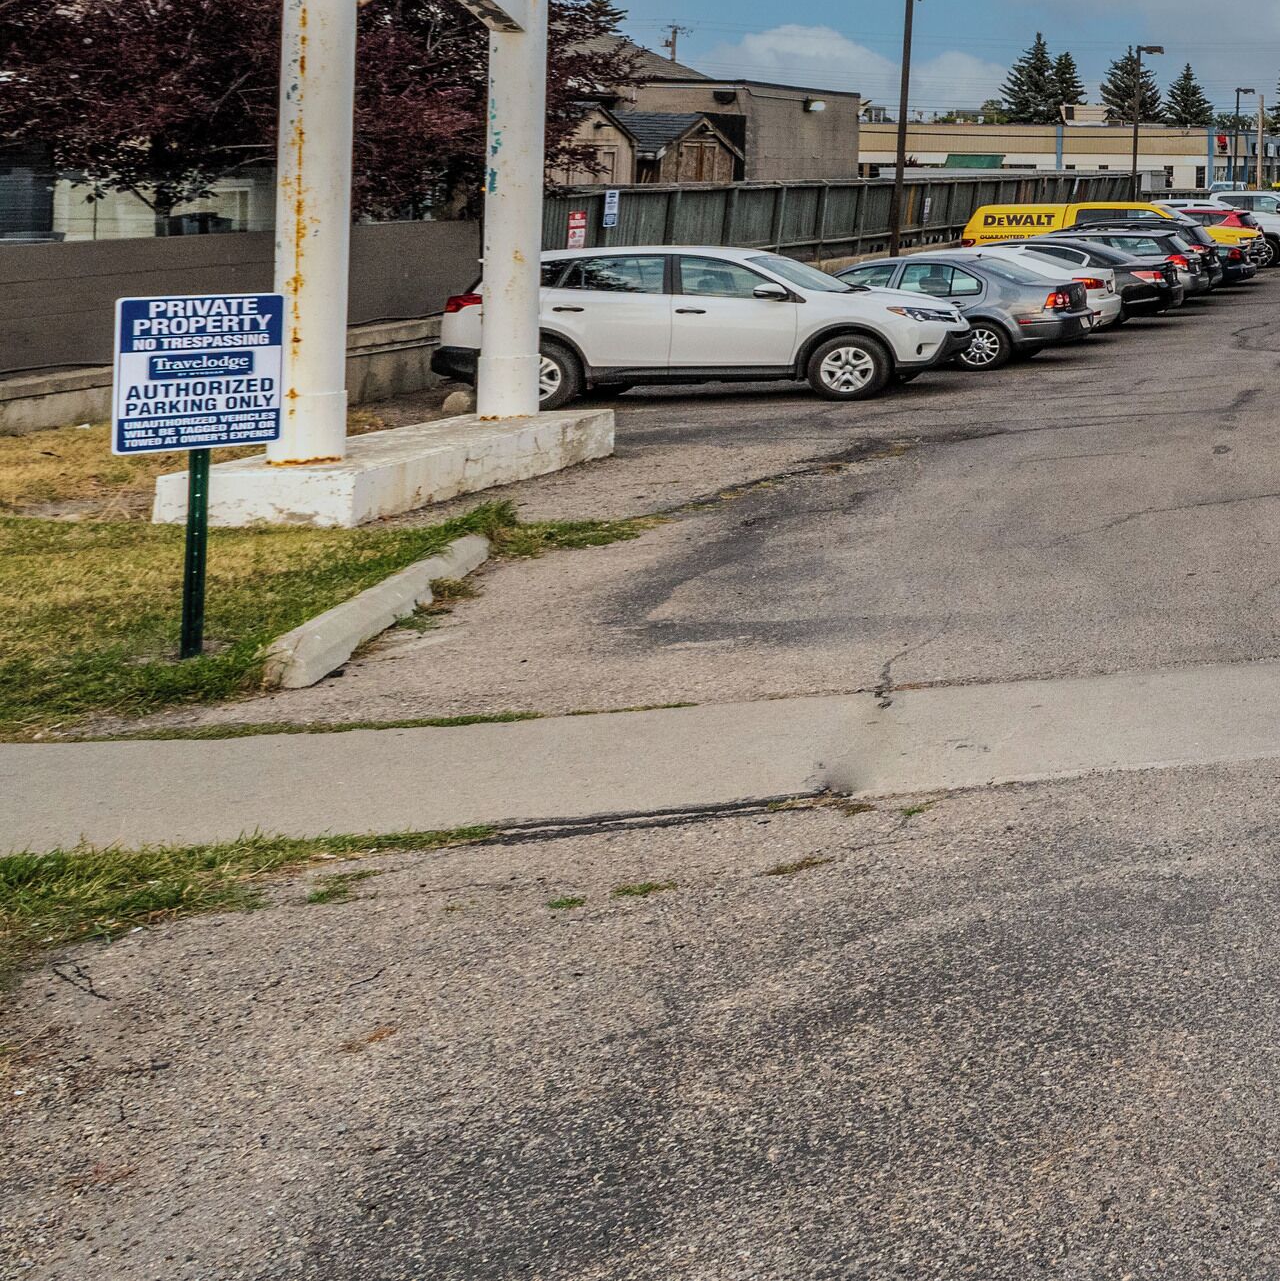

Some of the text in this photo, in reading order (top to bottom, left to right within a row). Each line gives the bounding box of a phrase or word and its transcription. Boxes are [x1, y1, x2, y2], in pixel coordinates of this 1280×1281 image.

[148, 298, 259, 318] PRIVATE
[132, 314, 273, 336] PROPERTY
[132, 333, 270, 351] NO TRESPASSING
[152, 355, 249, 371] Travelodge
[125, 377, 275, 401] AUTHORIZED
[125, 394, 275, 416] PARKING ONLY
[123, 412, 277, 430] UNAUTHORIZED VEHICLES
[123, 420, 276, 439] WILL BE TAGGED AND OR
[123, 429, 276, 448] TOWED AT OWNER'S EXPENSE
